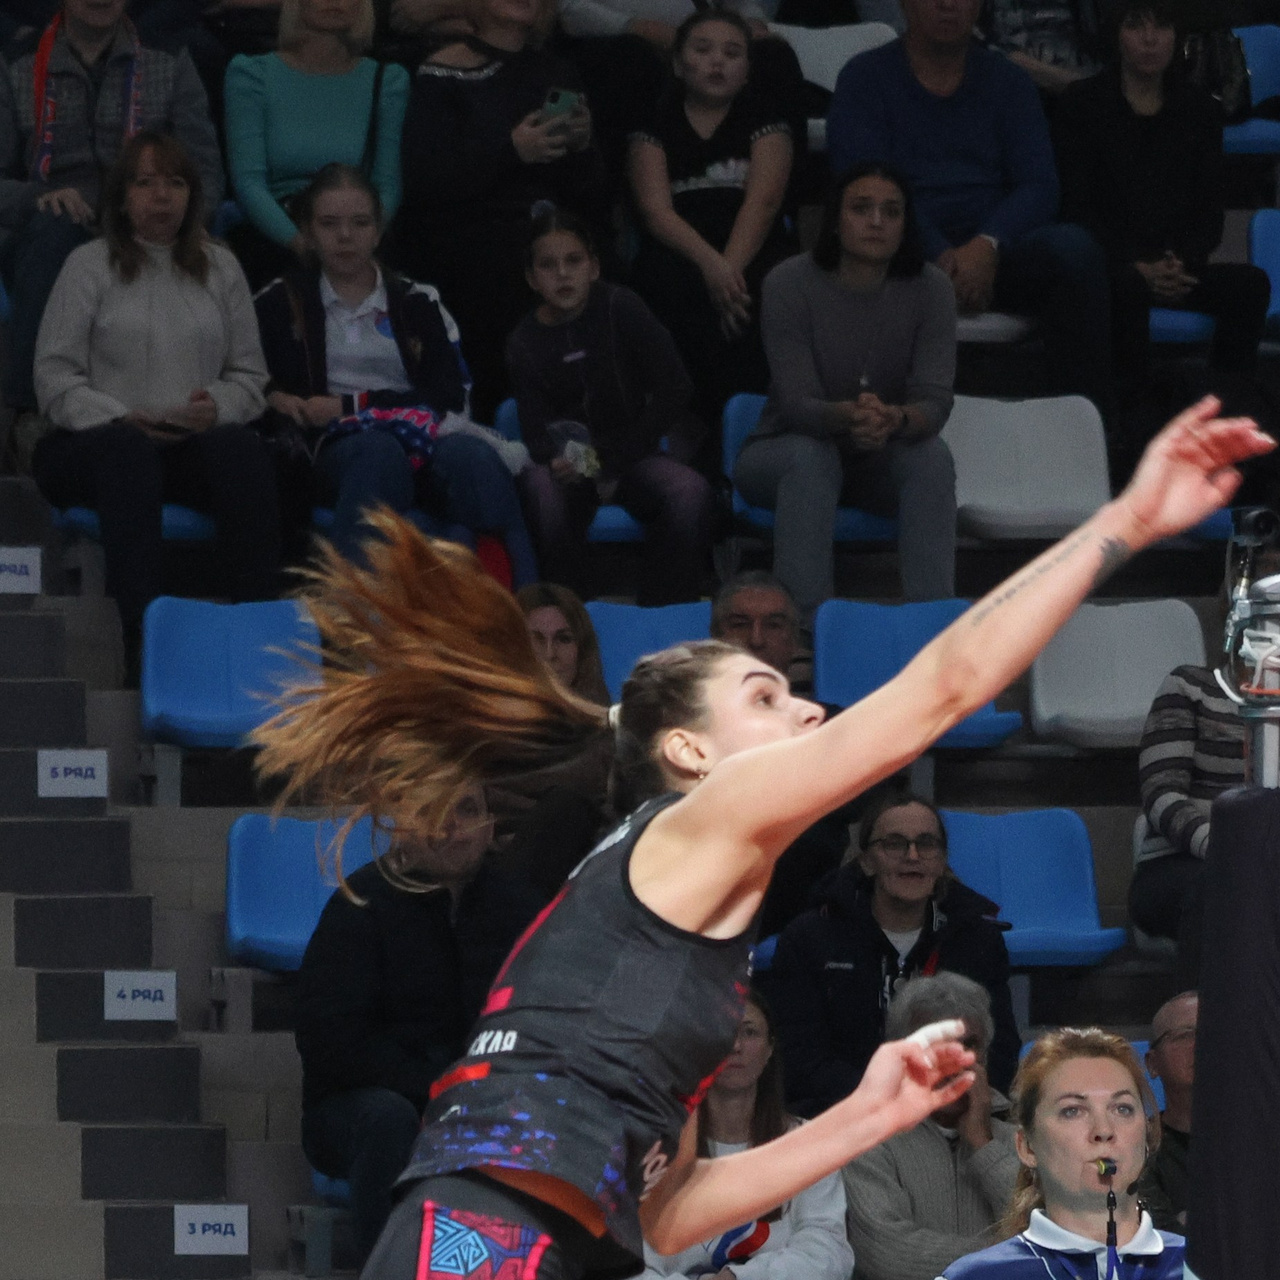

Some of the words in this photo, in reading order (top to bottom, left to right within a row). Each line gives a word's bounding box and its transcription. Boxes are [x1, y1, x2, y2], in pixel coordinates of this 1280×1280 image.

[50, 767, 59, 779] 5
[63, 767, 96, 780] РЯД
[131, 989, 164, 1002] РЯД
[188, 1222, 197, 1235] 3
[201, 1222, 236, 1237] РЯД
